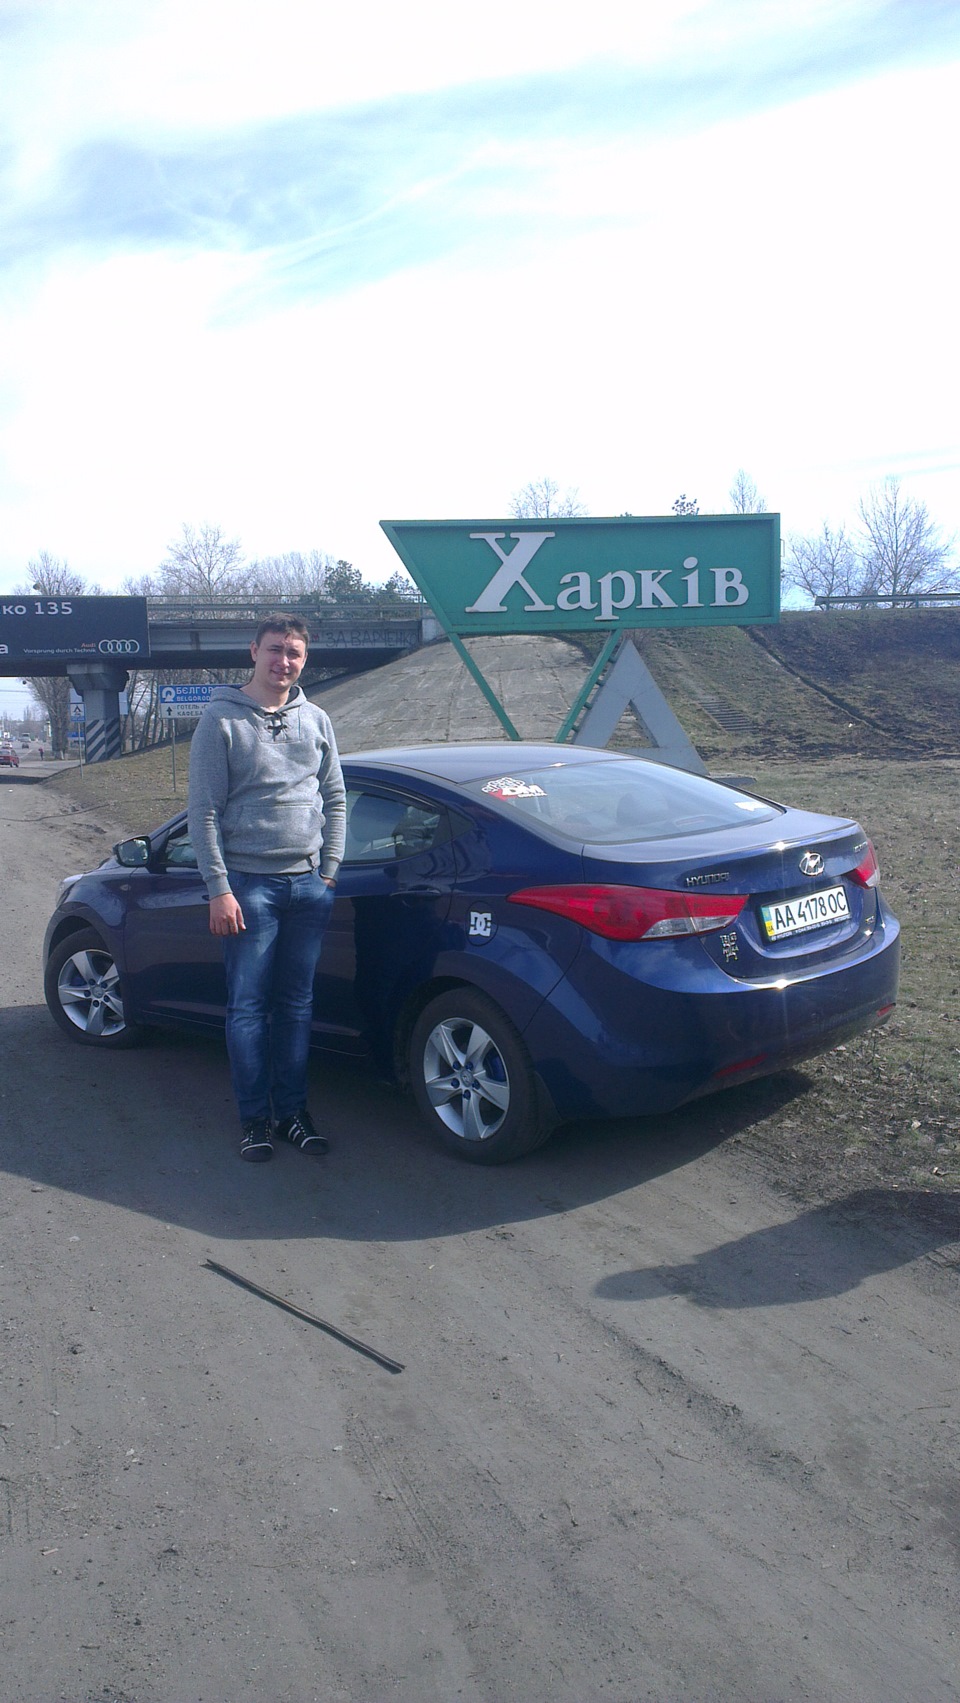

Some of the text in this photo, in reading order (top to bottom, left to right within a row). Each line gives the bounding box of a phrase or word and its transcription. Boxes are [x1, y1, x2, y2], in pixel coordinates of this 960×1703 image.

[464, 531, 750, 621] Харків
[0, 602, 73, 615] ко 135
[176, 687, 214, 695] БЄЛГОР
[685, 872, 730, 887] HYUNDAI
[798, 896, 827, 922] 4178
